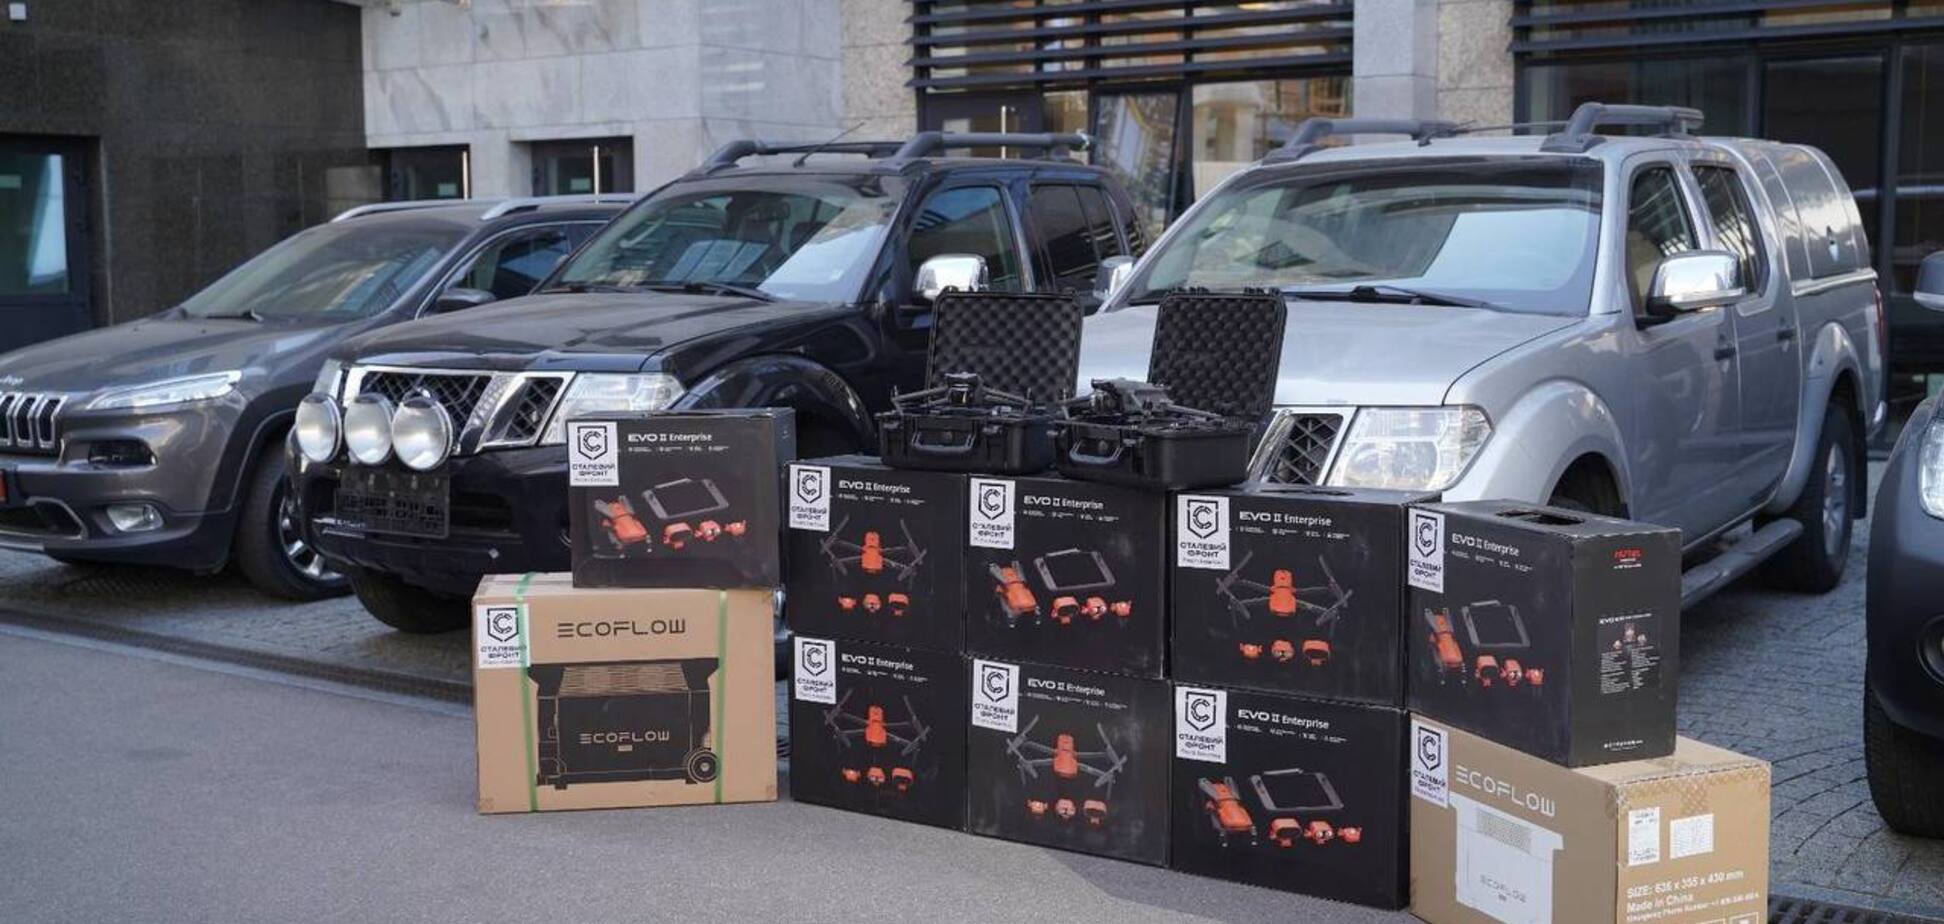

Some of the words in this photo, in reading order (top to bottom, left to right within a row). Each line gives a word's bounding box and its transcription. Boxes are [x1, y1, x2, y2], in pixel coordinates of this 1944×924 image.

[628, 433, 658, 442] EVO
[669, 433, 712, 443] Enterprise
[838, 480, 864, 490] EVO
[873, 483, 911, 494] Enterprise
[1024, 495, 1051, 506] EVO
[1062, 499, 1104, 510] Enterprise
[1239, 511, 1271, 521] EVO
[1284, 514, 1332, 527] Enterprise
[1451, 533, 1475, 546] EVO
[1484, 539, 1520, 557] Enterprise
[557, 619, 686, 638] ECOFLOW
[841, 653, 867, 664] EVO
[876, 658, 914, 671] Enterprise
[1027, 678, 1056, 690] EVO
[1066, 683, 1105, 696] Enterprise
[1238, 709, 1270, 721] EVO
[1282, 714, 1330, 729] Enterprise
[579, 730, 670, 744] ECOFLOW
[1456, 764, 1556, 817] ECOFLOW
[1627, 885, 1653, 899] SIZE:
[1627, 901, 1653, 913] Made
[1655, 898, 1665, 907] in
[1666, 894, 1694, 905] China
